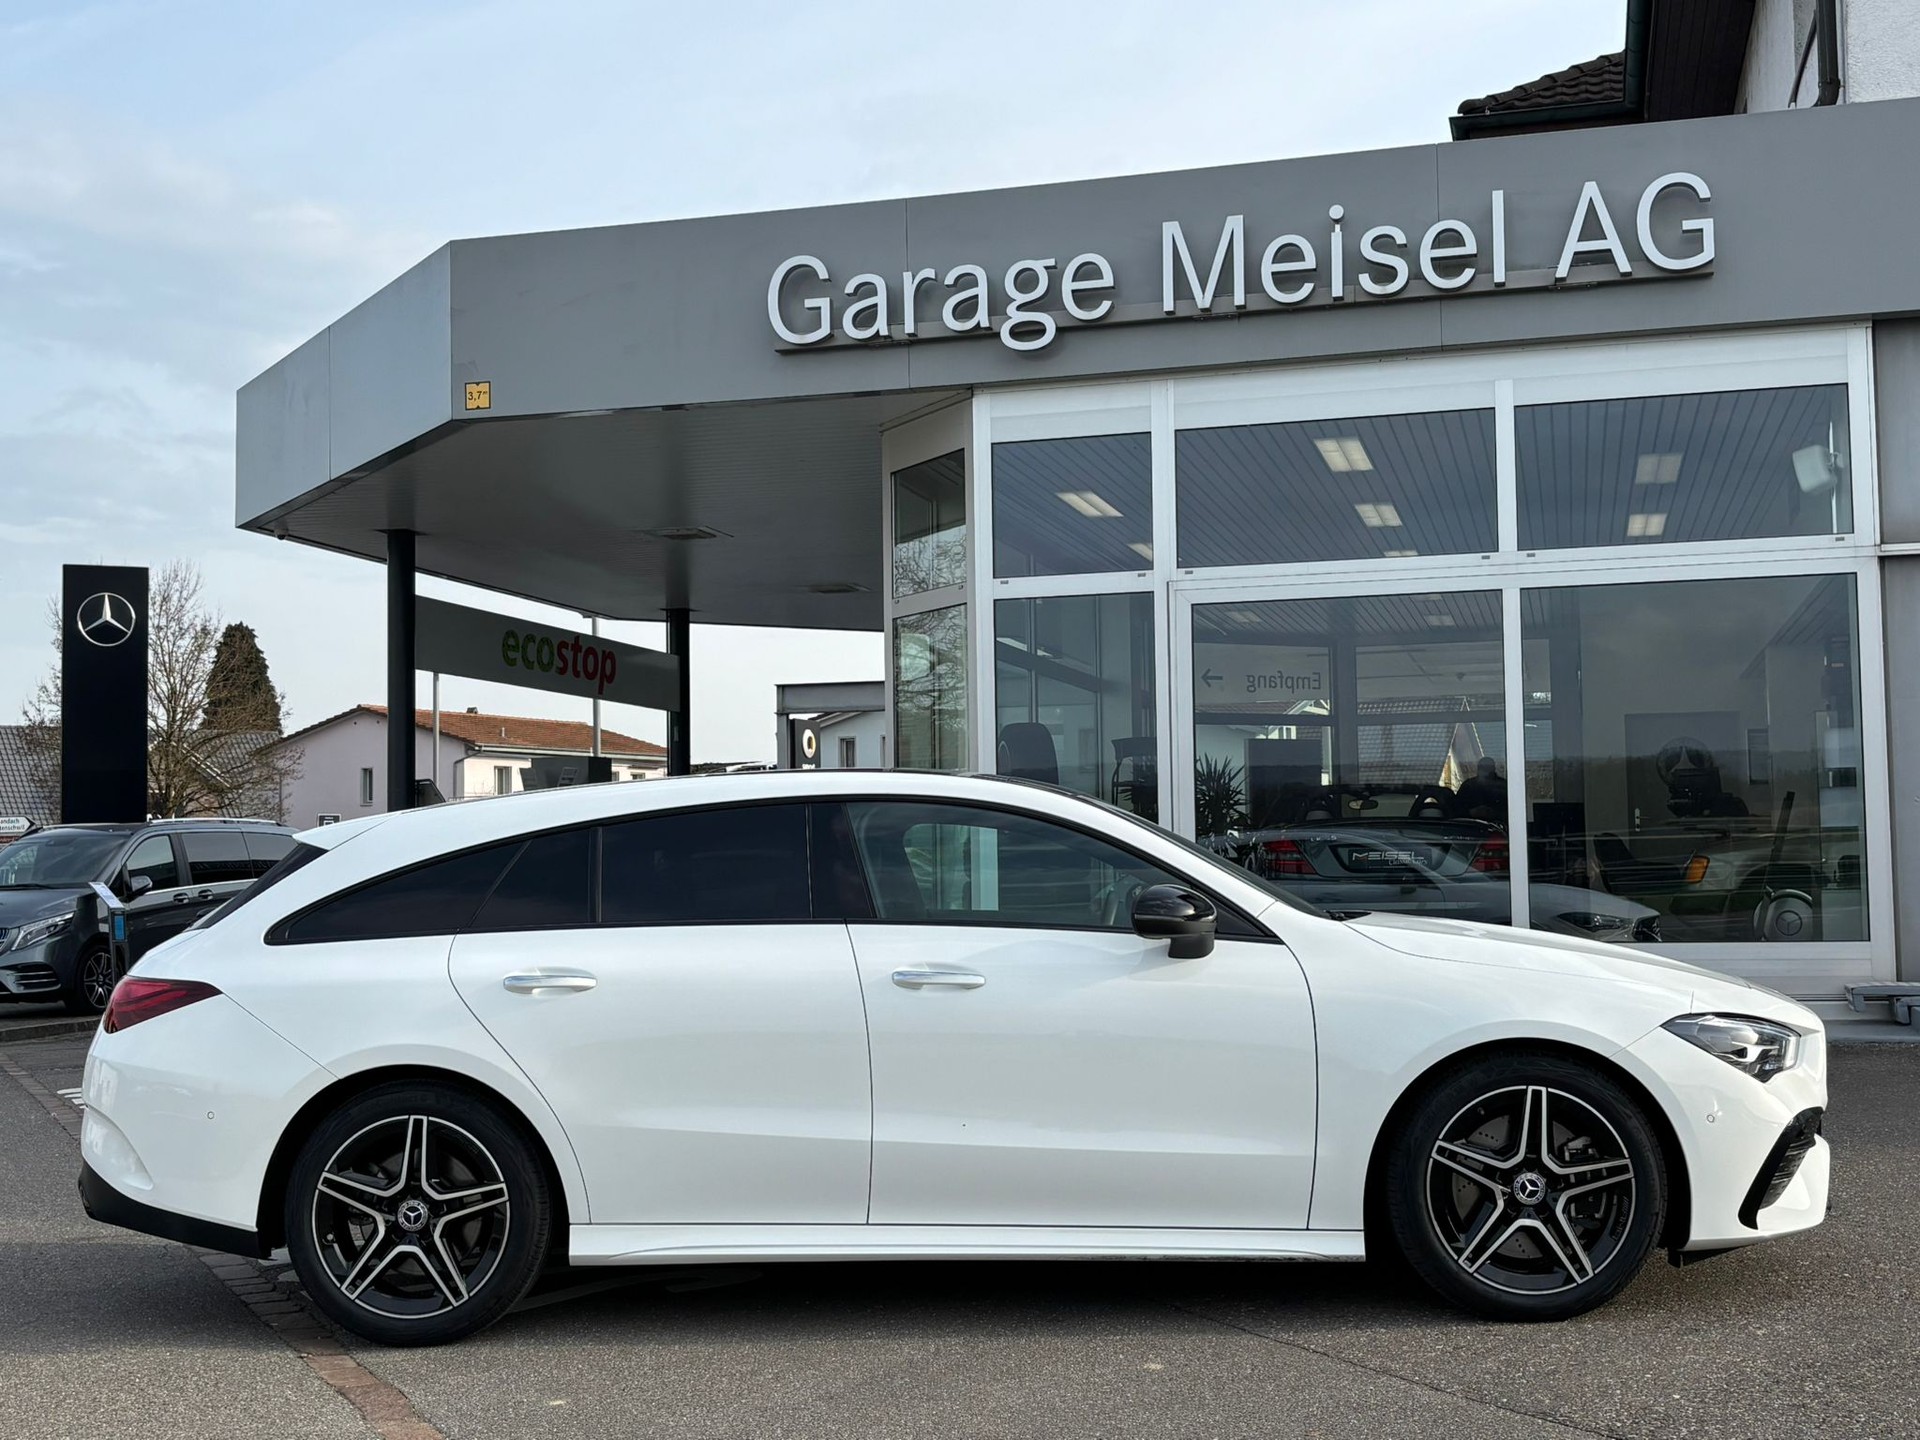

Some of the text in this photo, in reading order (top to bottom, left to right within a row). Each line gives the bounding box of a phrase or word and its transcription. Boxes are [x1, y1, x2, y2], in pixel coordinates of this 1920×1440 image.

[767, 171, 1716, 351] Garage Meisel AG
[501, 629, 617, 696] ecostop
[1352, 851, 1424, 861] MEISEL
